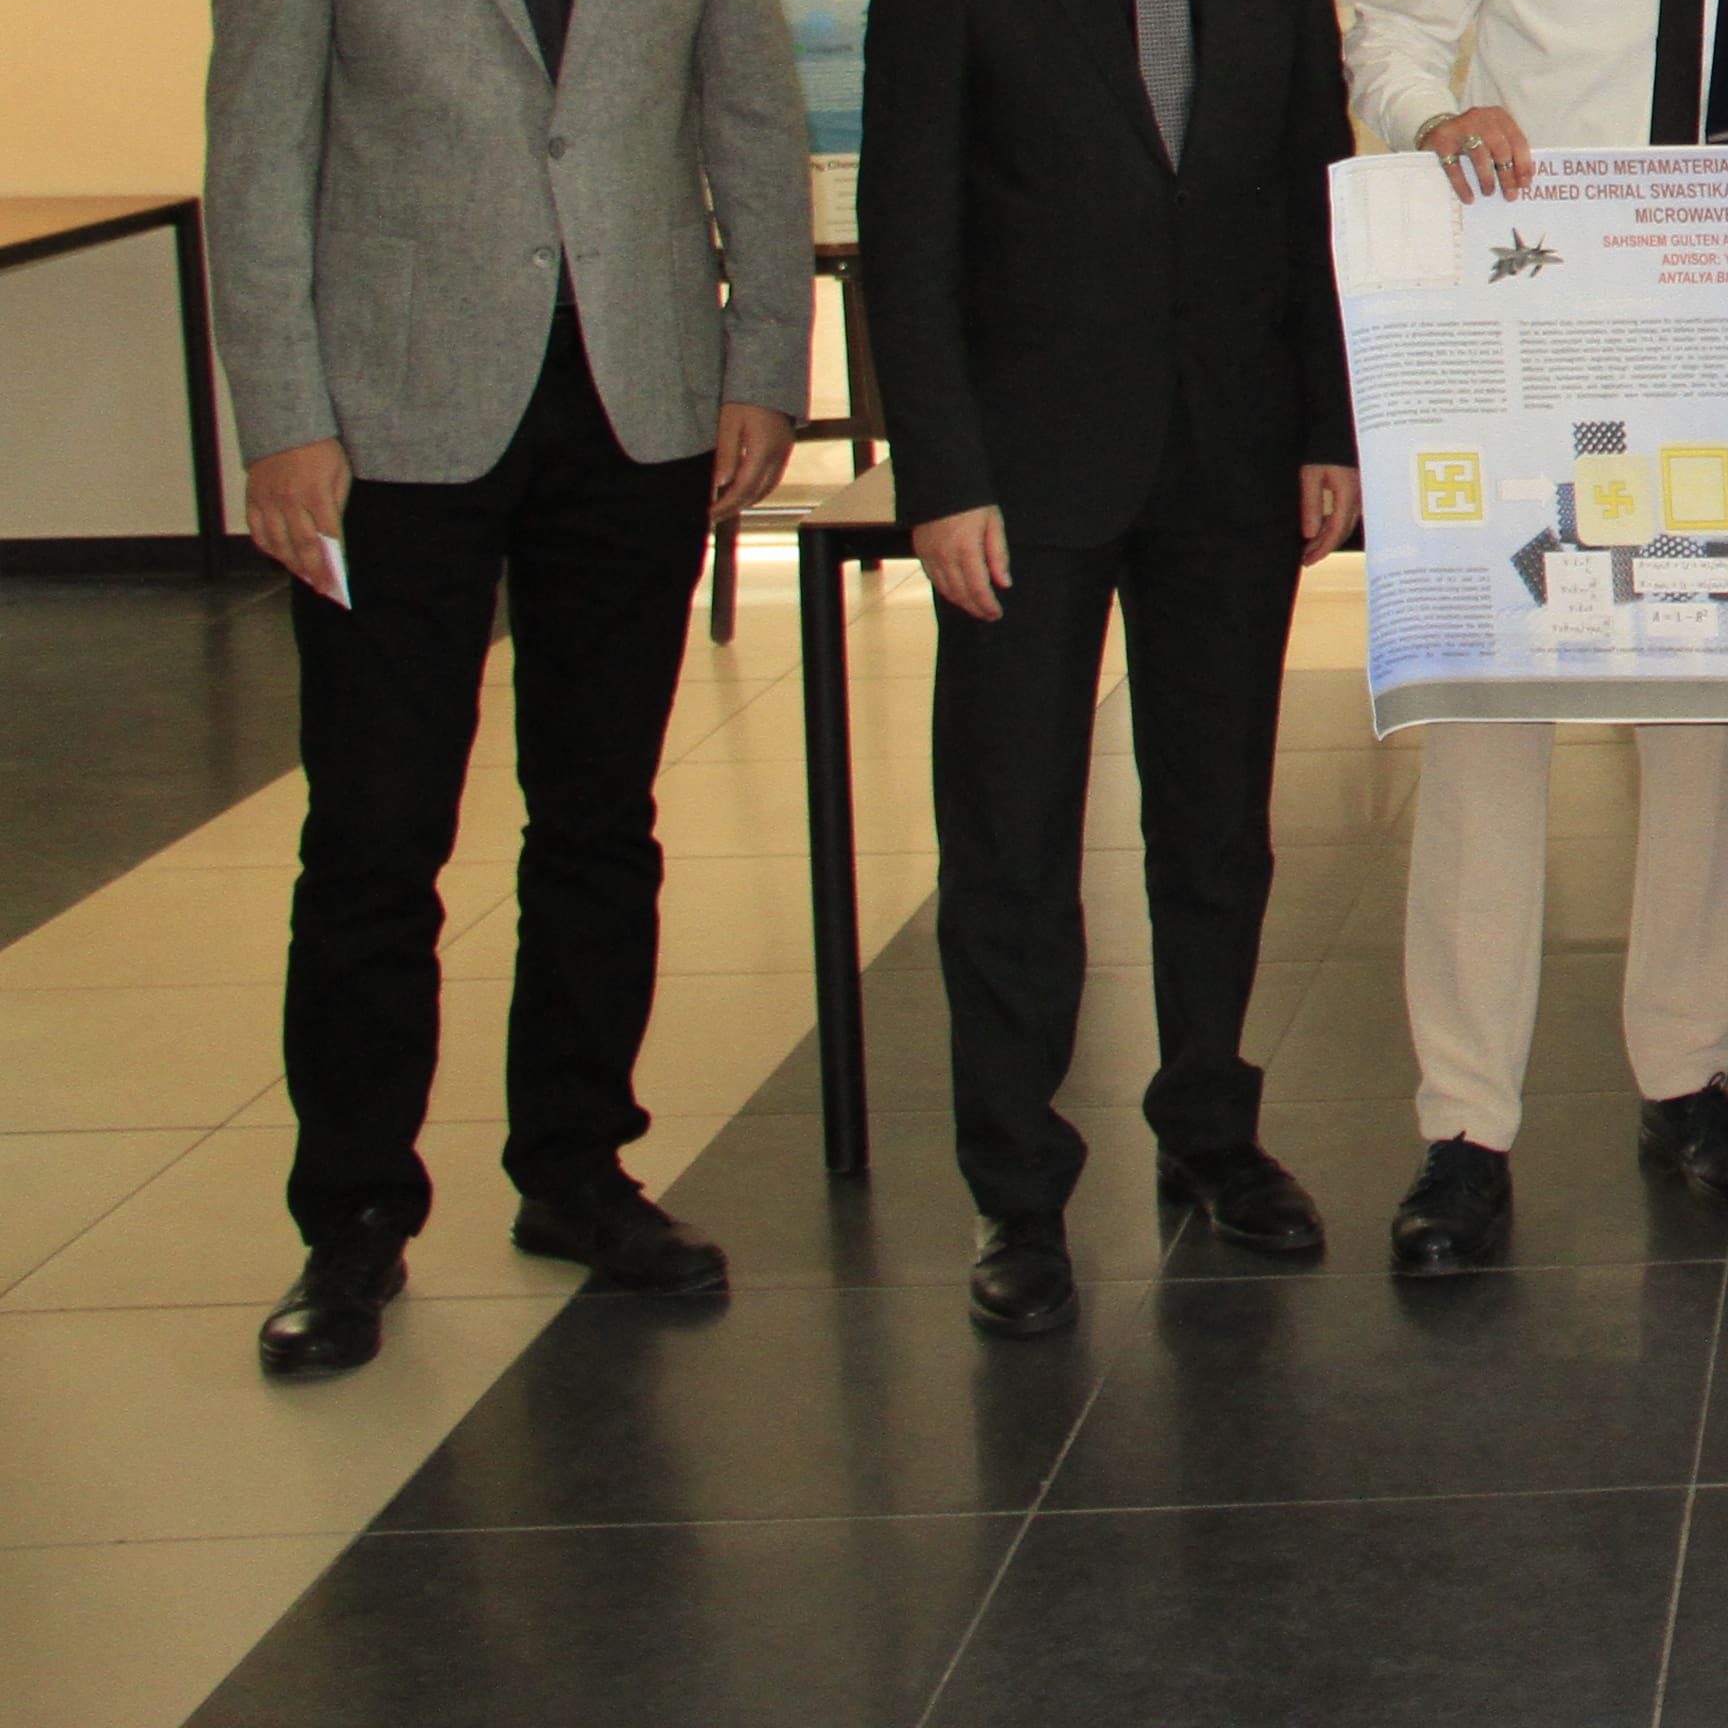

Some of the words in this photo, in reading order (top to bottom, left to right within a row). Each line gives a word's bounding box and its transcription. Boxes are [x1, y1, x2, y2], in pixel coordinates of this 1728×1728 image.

[1564, 160, 1608, 176] BAND
[1519, 184, 1579, 200] RAMED
[1585, 184, 1645, 199] CHRIAL
[1603, 234, 1667, 247] SAHSINEM
[1663, 253, 1721, 266] ADVISOR:
[1658, 272, 1713, 284] ANTALYA
